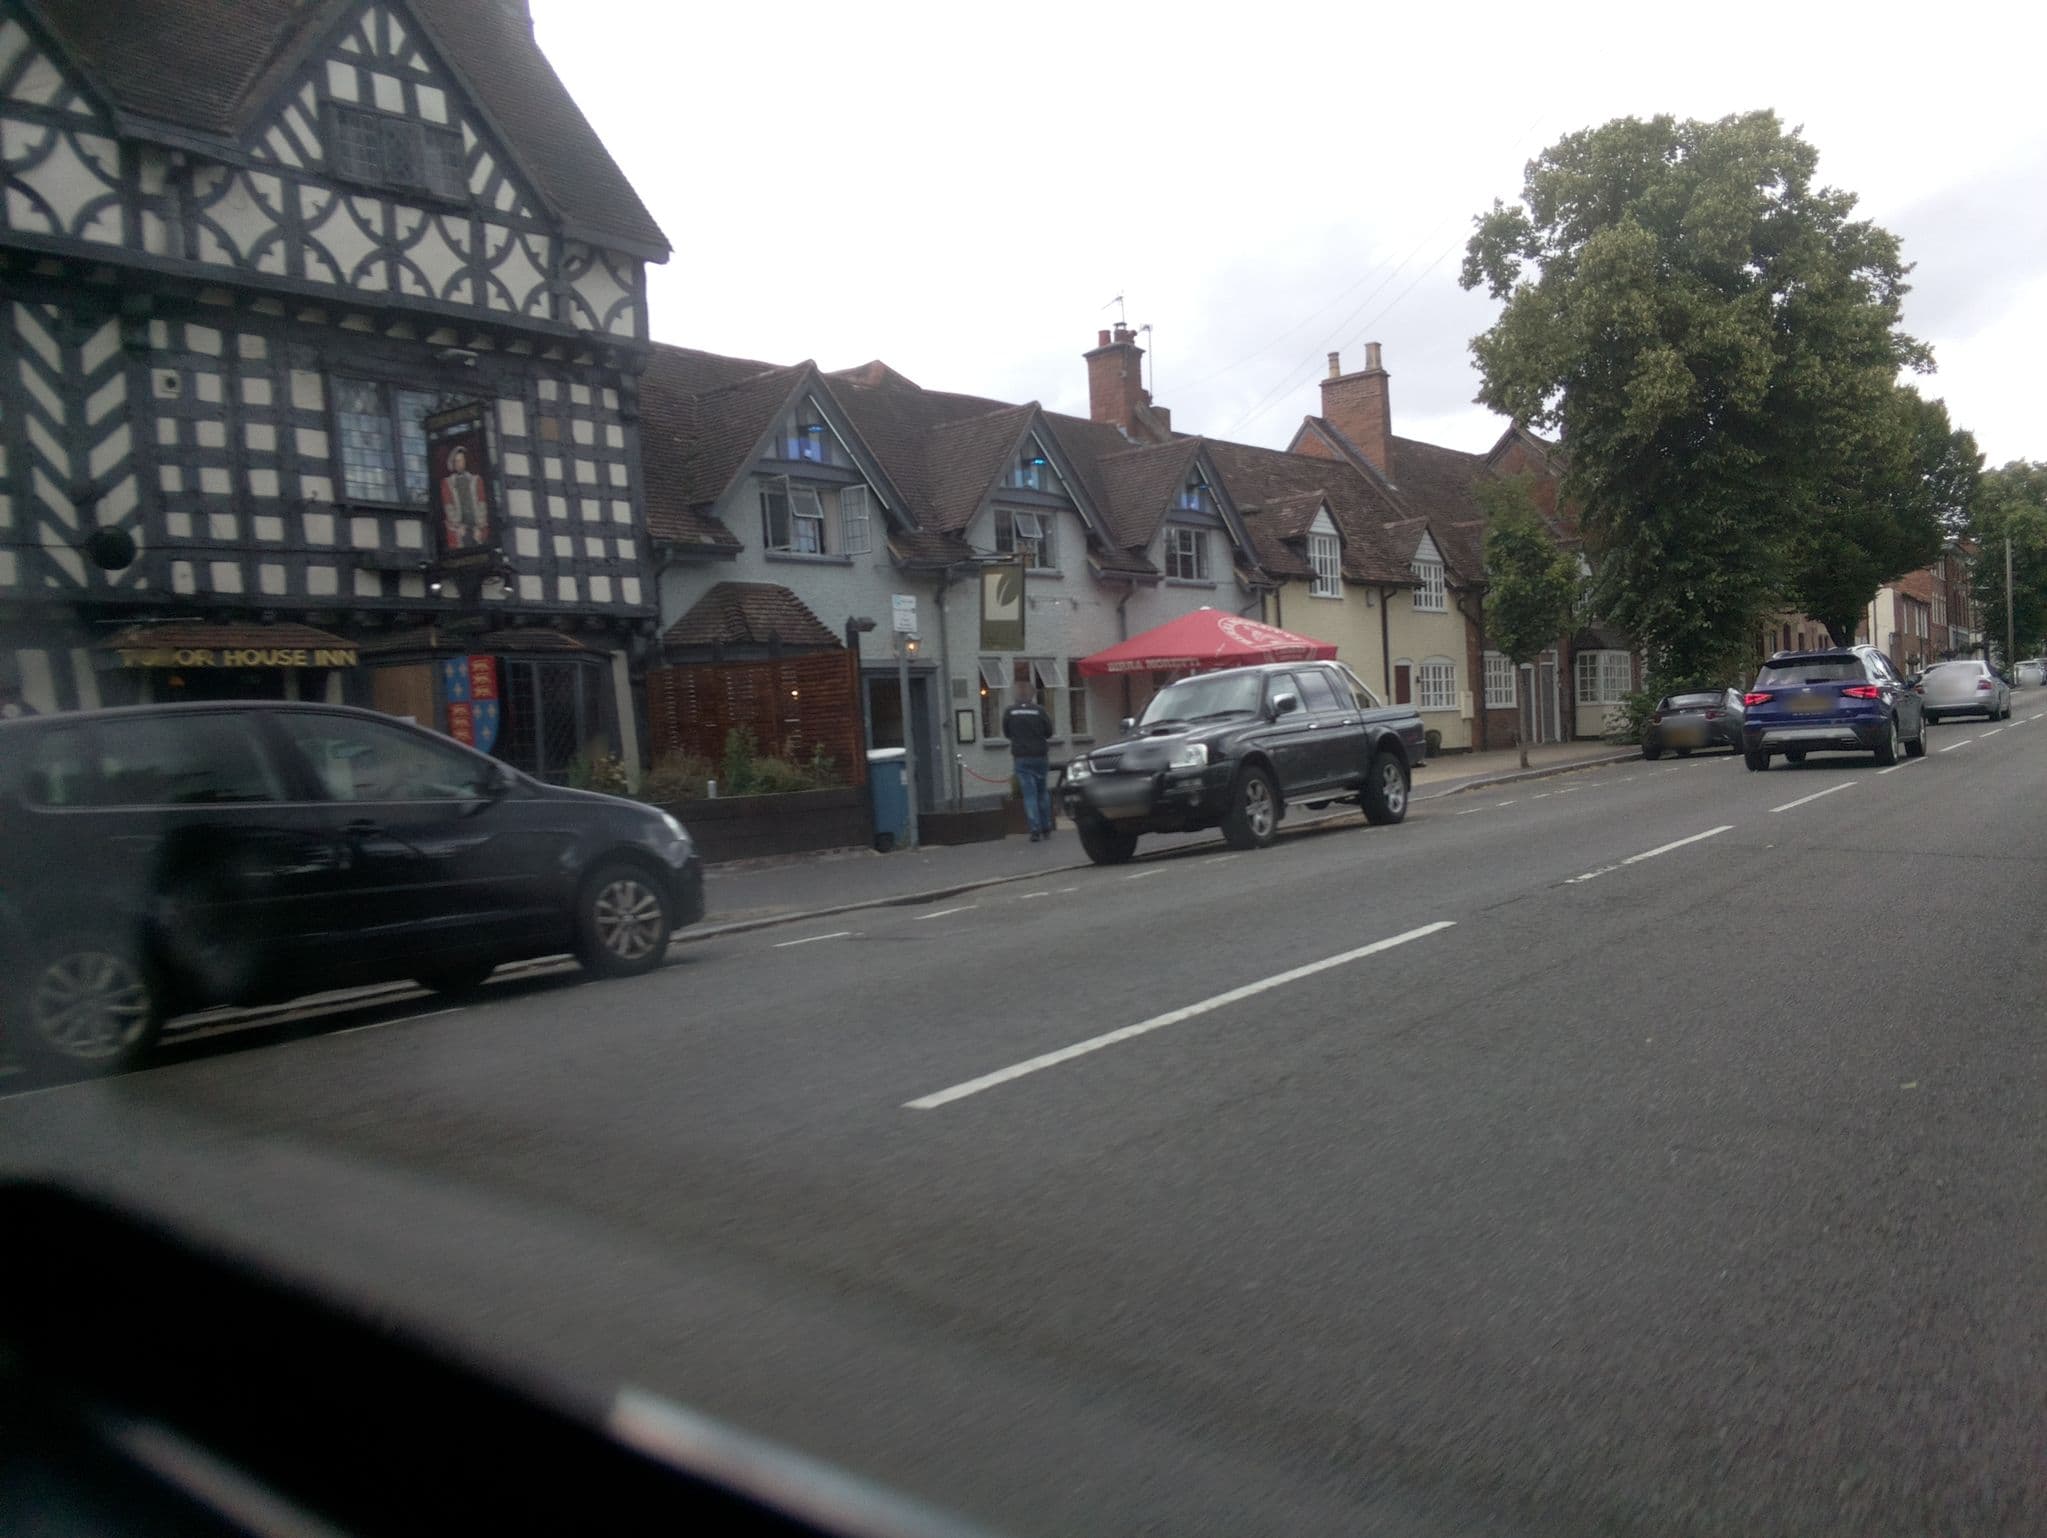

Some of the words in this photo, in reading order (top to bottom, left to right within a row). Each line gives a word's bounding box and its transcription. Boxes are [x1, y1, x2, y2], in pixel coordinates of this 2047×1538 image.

[118, 648, 215, 667] TUOR
[223, 649, 308, 667] HOUSE
[314, 649, 358, 667] INN
